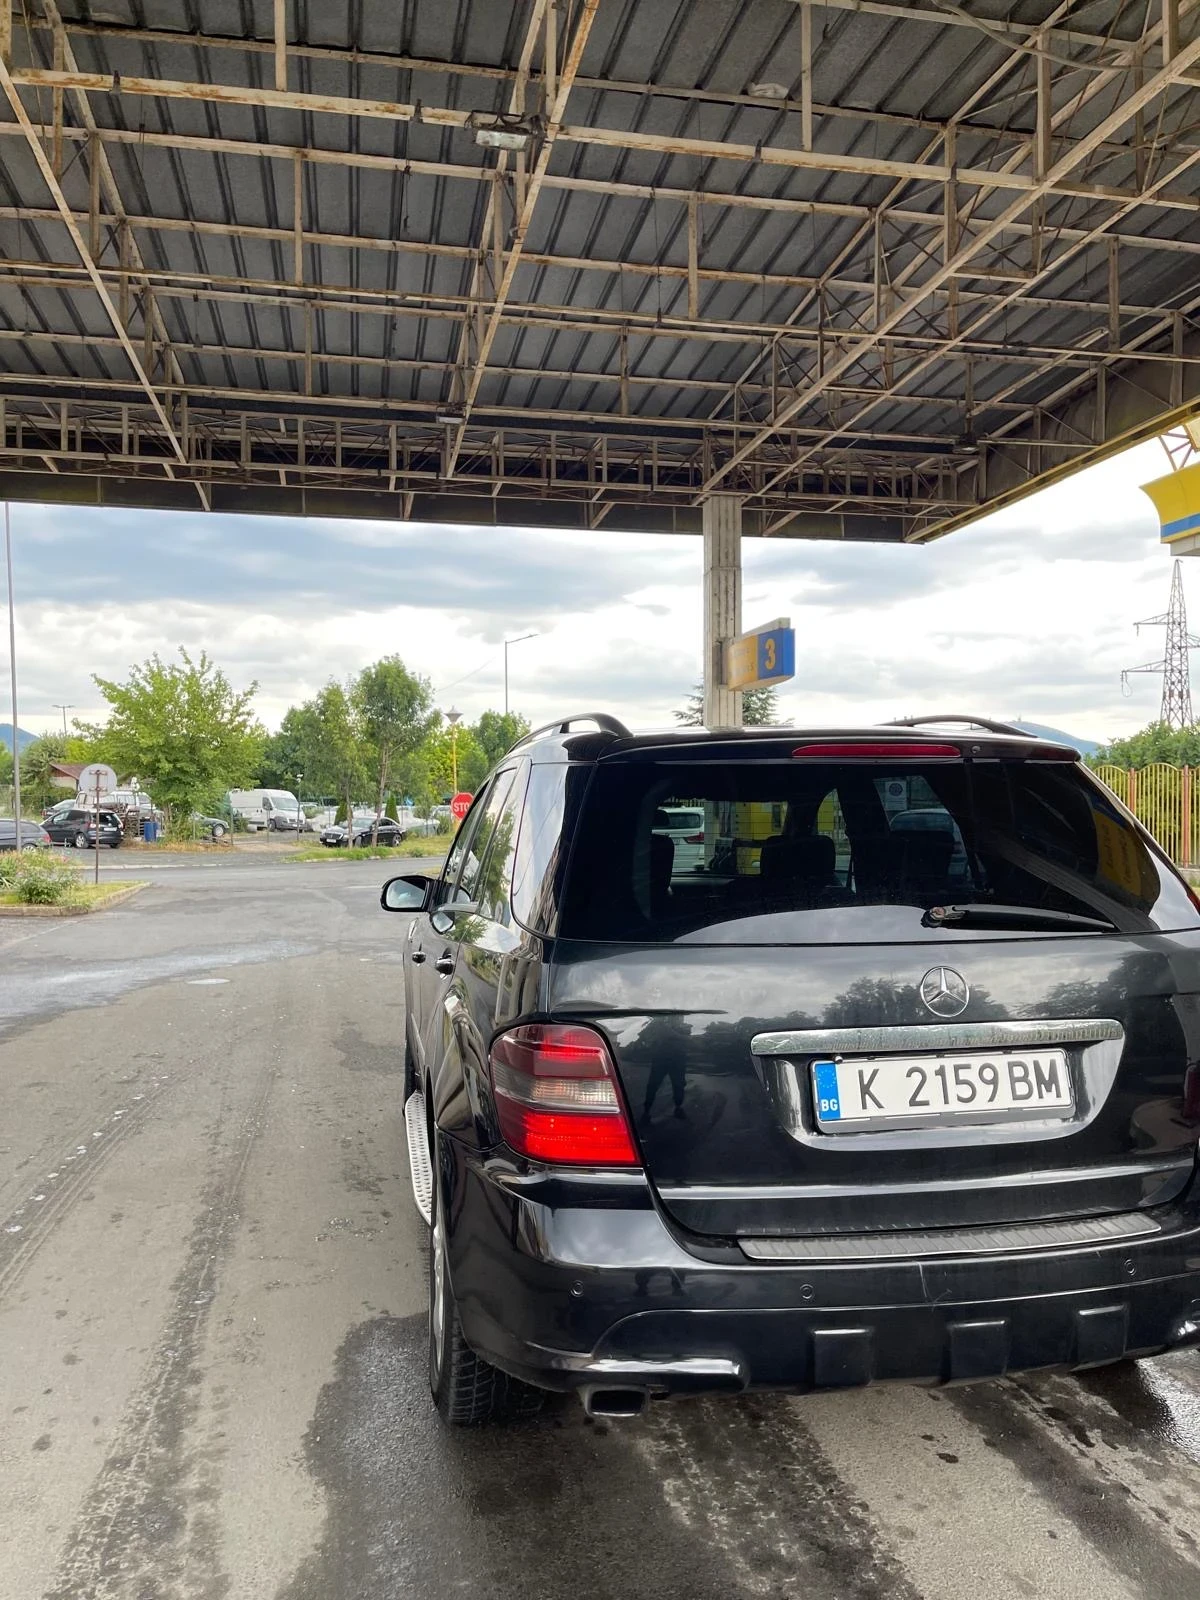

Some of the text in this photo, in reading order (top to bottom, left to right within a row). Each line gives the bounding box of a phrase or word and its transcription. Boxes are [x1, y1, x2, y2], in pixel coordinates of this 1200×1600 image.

[765, 638, 776, 670] 3
[453, 801, 470, 813] STO
[858, 1068, 884, 1110] K
[821, 1099, 838, 1112] BG
